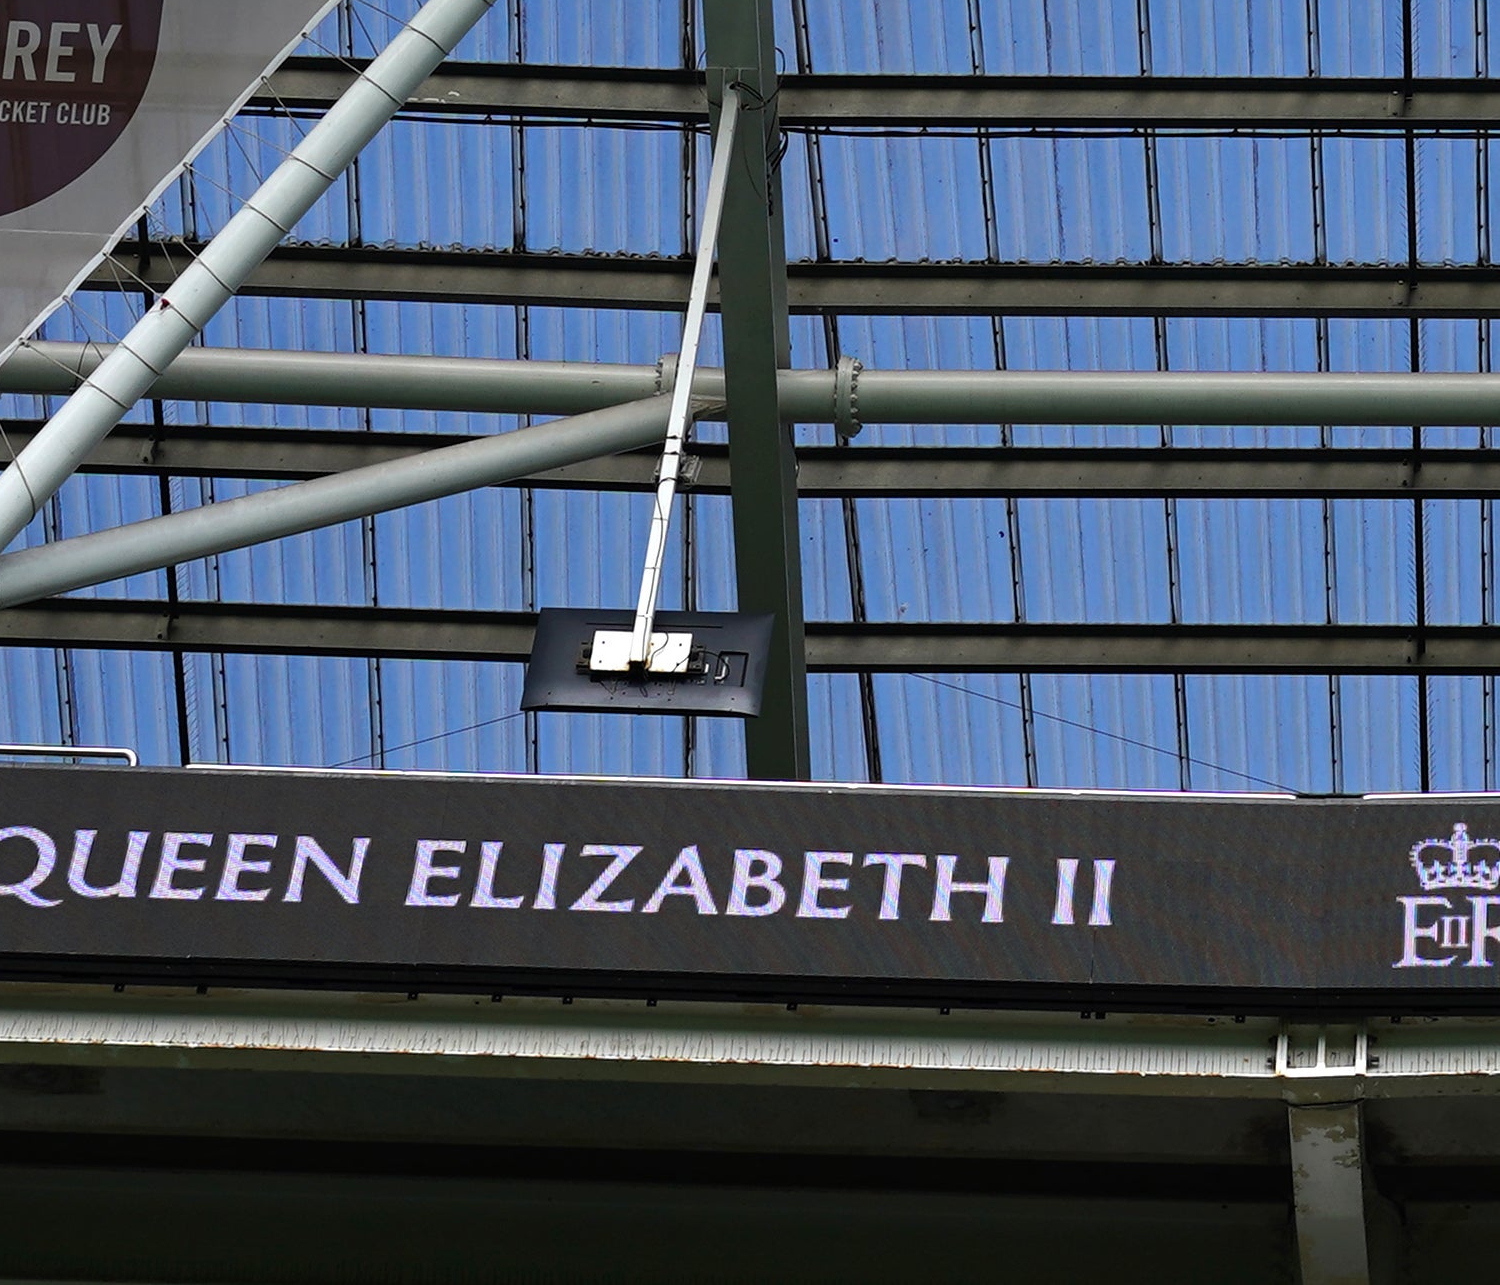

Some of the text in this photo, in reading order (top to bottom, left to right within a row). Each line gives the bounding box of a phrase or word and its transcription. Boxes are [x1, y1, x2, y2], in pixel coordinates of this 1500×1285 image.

[56, 100, 112, 126] CLUB
[404, 838, 1010, 925] ELIZABETH
[1050, 857, 1117, 928] II
